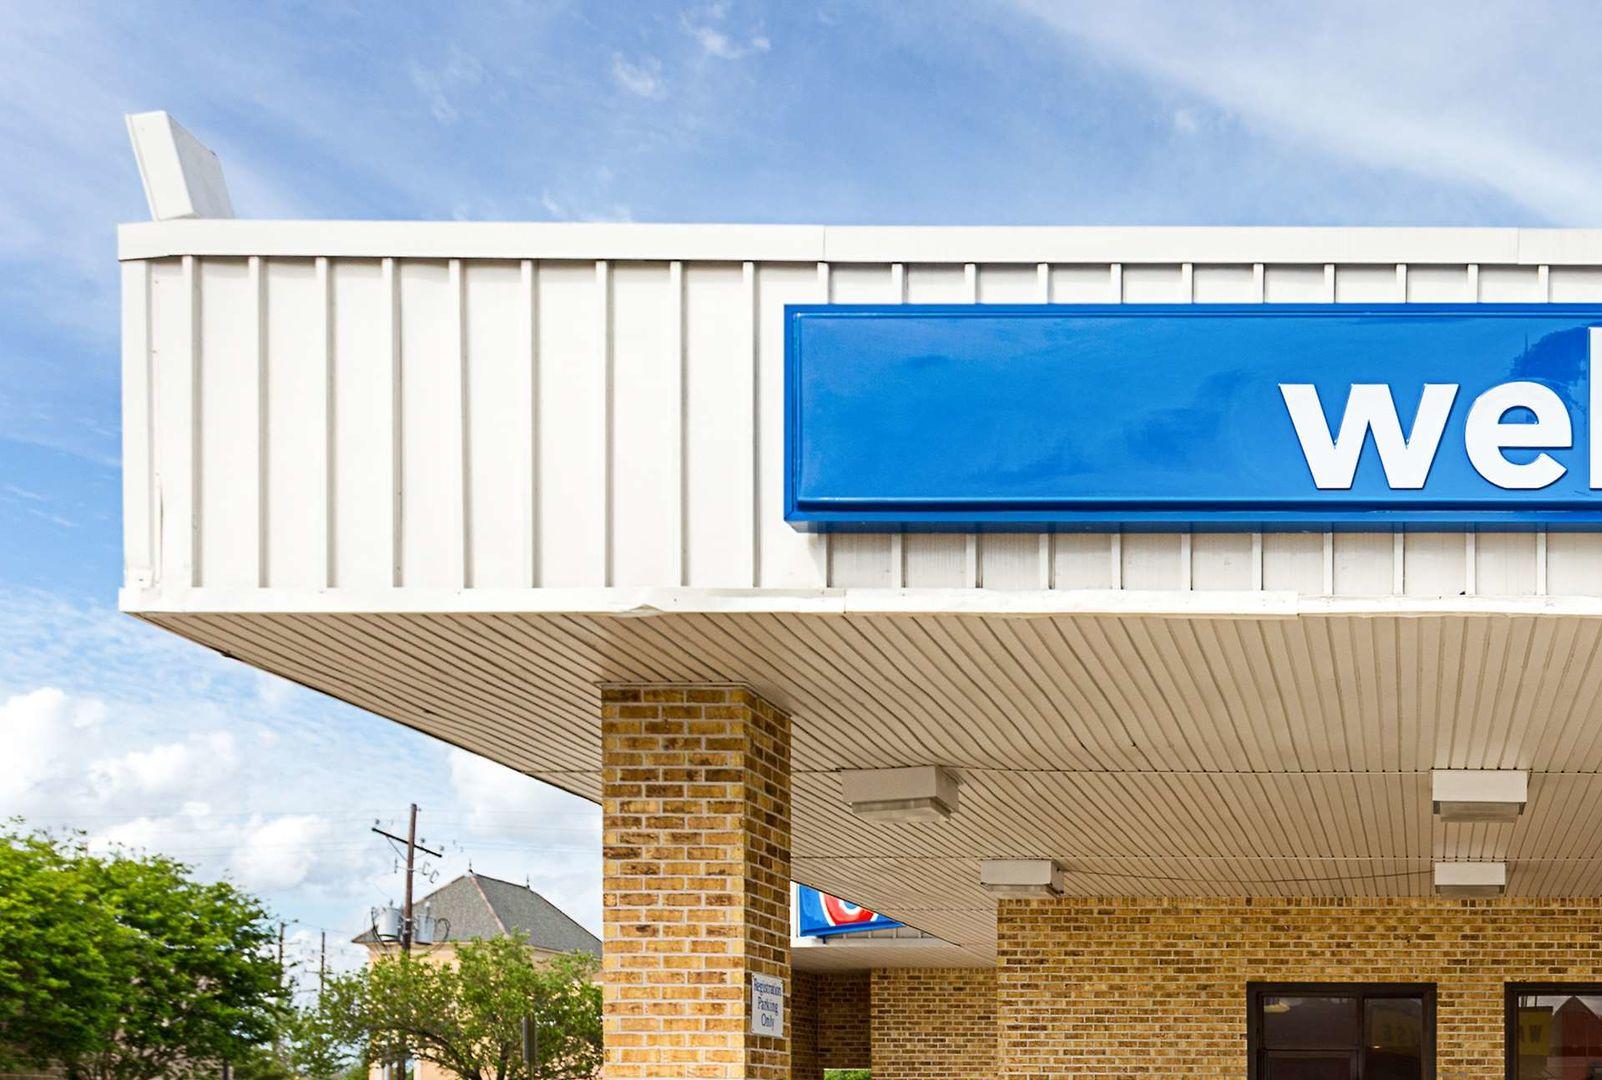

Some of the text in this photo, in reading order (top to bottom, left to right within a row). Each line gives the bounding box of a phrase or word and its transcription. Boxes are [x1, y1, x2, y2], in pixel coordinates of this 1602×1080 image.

[753, 978, 782, 997] Registration
[757, 996, 779, 1016] Parking
[761, 1013, 774, 1031] Only
